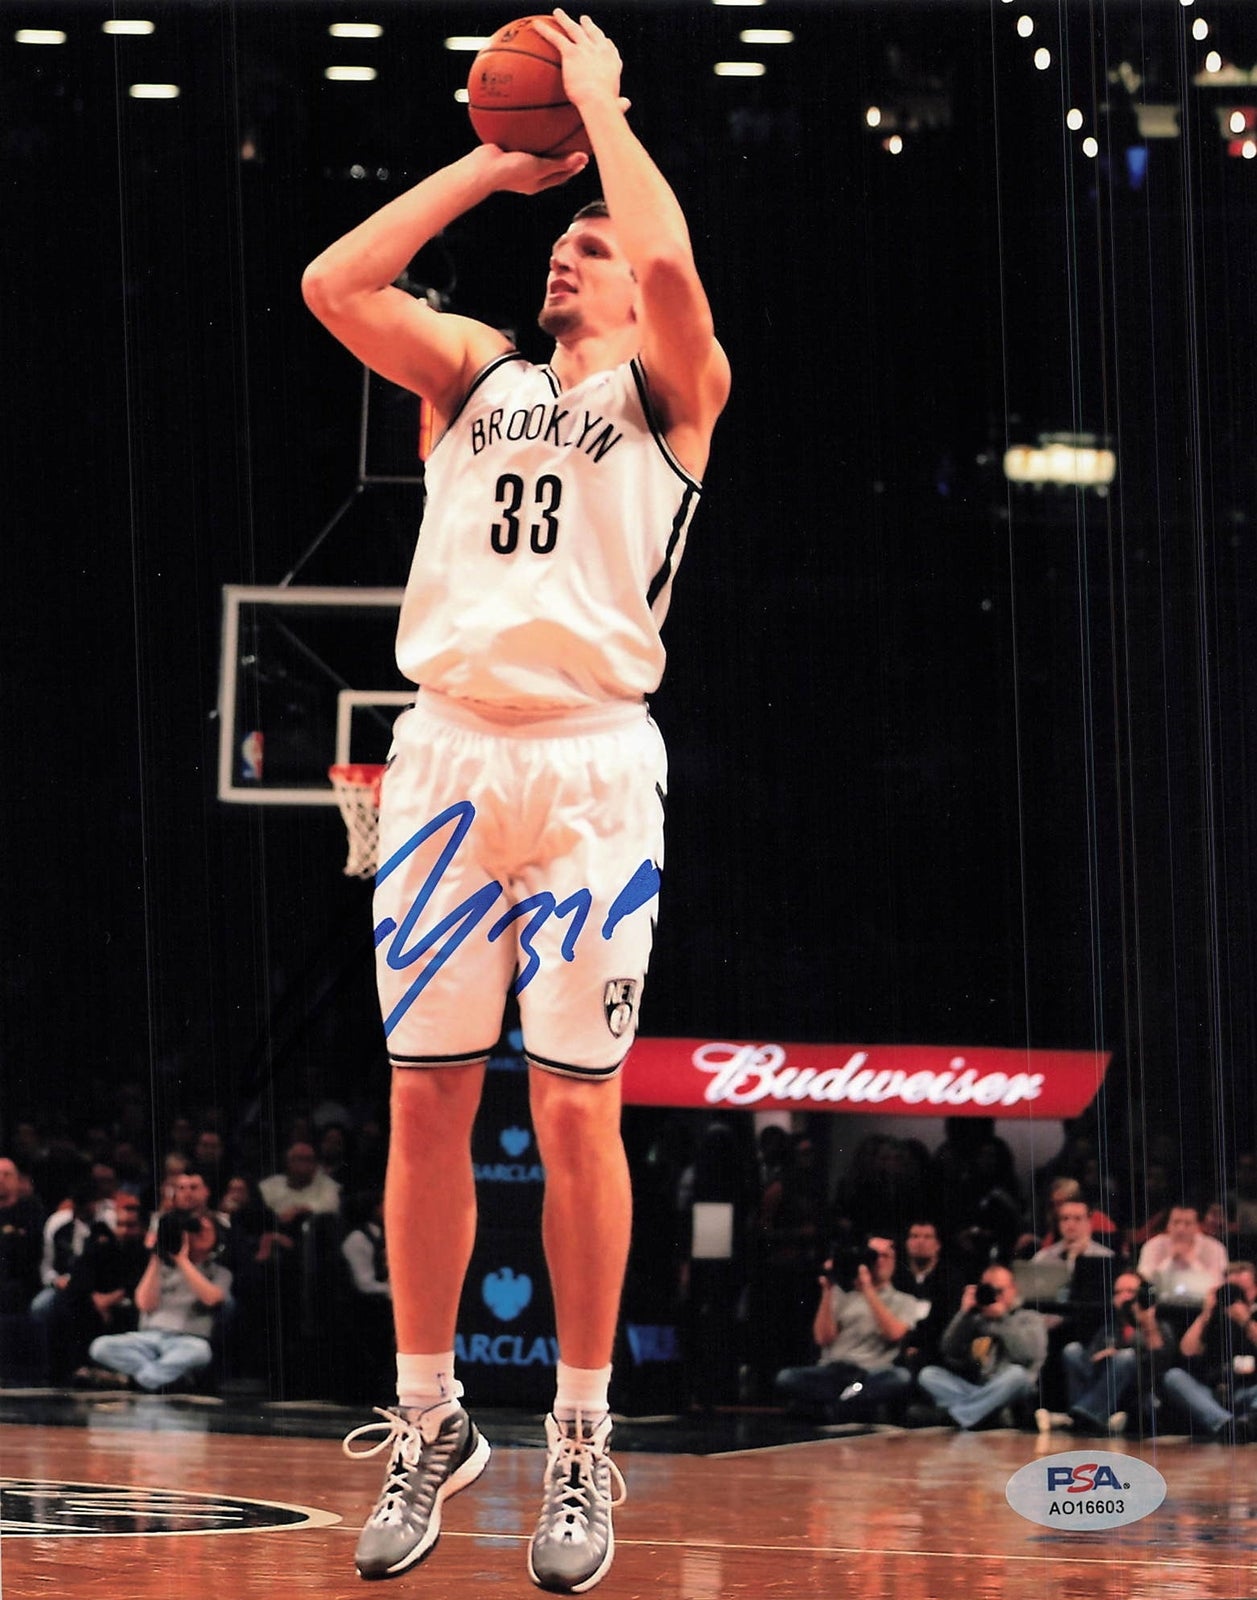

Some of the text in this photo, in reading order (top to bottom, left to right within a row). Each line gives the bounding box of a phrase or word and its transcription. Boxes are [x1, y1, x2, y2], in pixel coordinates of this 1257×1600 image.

[472, 404, 623, 463] BROOKYN
[491, 474, 562, 554] 33
[692, 1043, 1045, 1105] Budweiser
